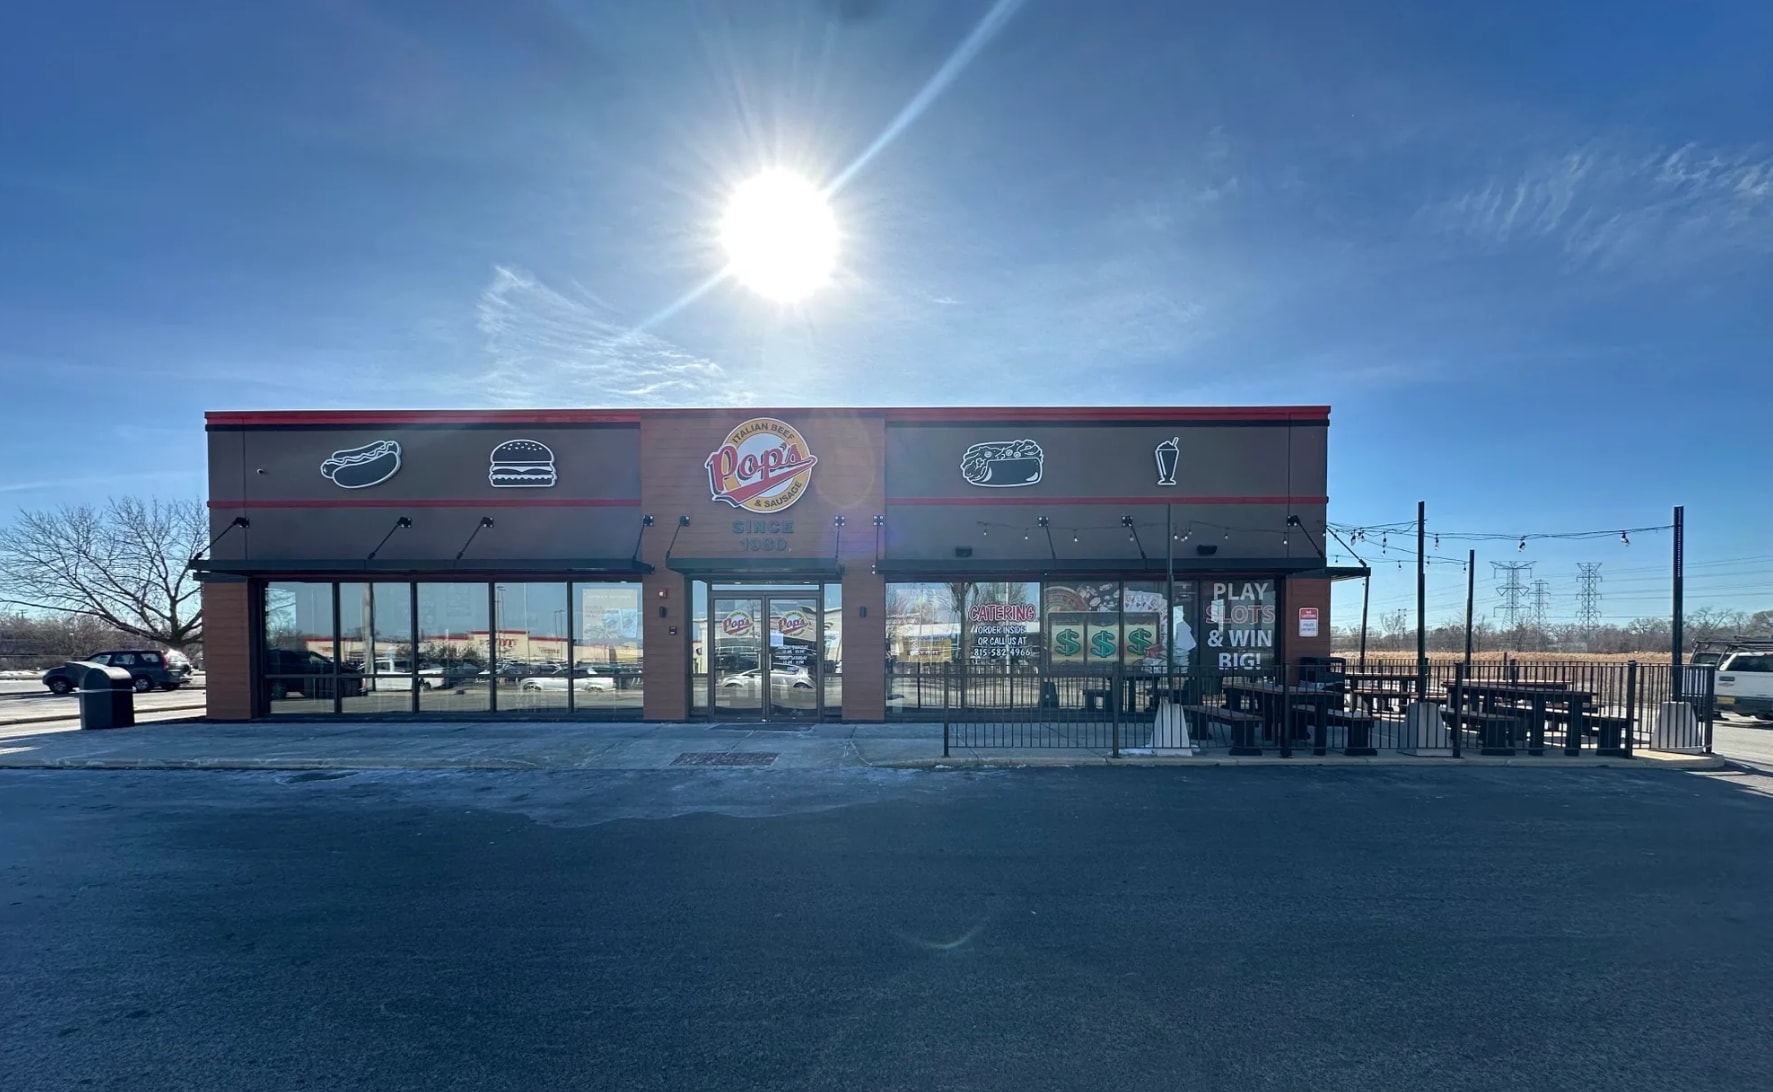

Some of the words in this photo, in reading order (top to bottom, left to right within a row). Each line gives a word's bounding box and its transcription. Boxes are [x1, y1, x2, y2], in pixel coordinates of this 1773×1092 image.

[732, 423, 769, 444] ITALIAN
[770, 423, 795, 441] BEEF
[705, 442, 804, 495] Pop's
[754, 499, 762, 508] &
[764, 481, 802, 508] SAUSAGE
[731, 520, 795, 534] SINCE
[741, 537, 788, 552] 1980
[1213, 582, 1269, 600] PLAY
[969, 603, 1036, 622] CATERING
[977, 625, 1001, 634] ORDER
[1002, 625, 1026, 634] INSIDE
[1207, 629, 1223, 647] &
[1228, 629, 1273, 647] WIN
[978, 637, 988, 645] OR
[989, 637, 1005, 645] CALL
[1007, 637, 1017, 645] US
[1018, 637, 1027, 645] AT
[974, 648, 1031, 657] 815-5824966
[1218, 652, 1261, 671] BIG!
